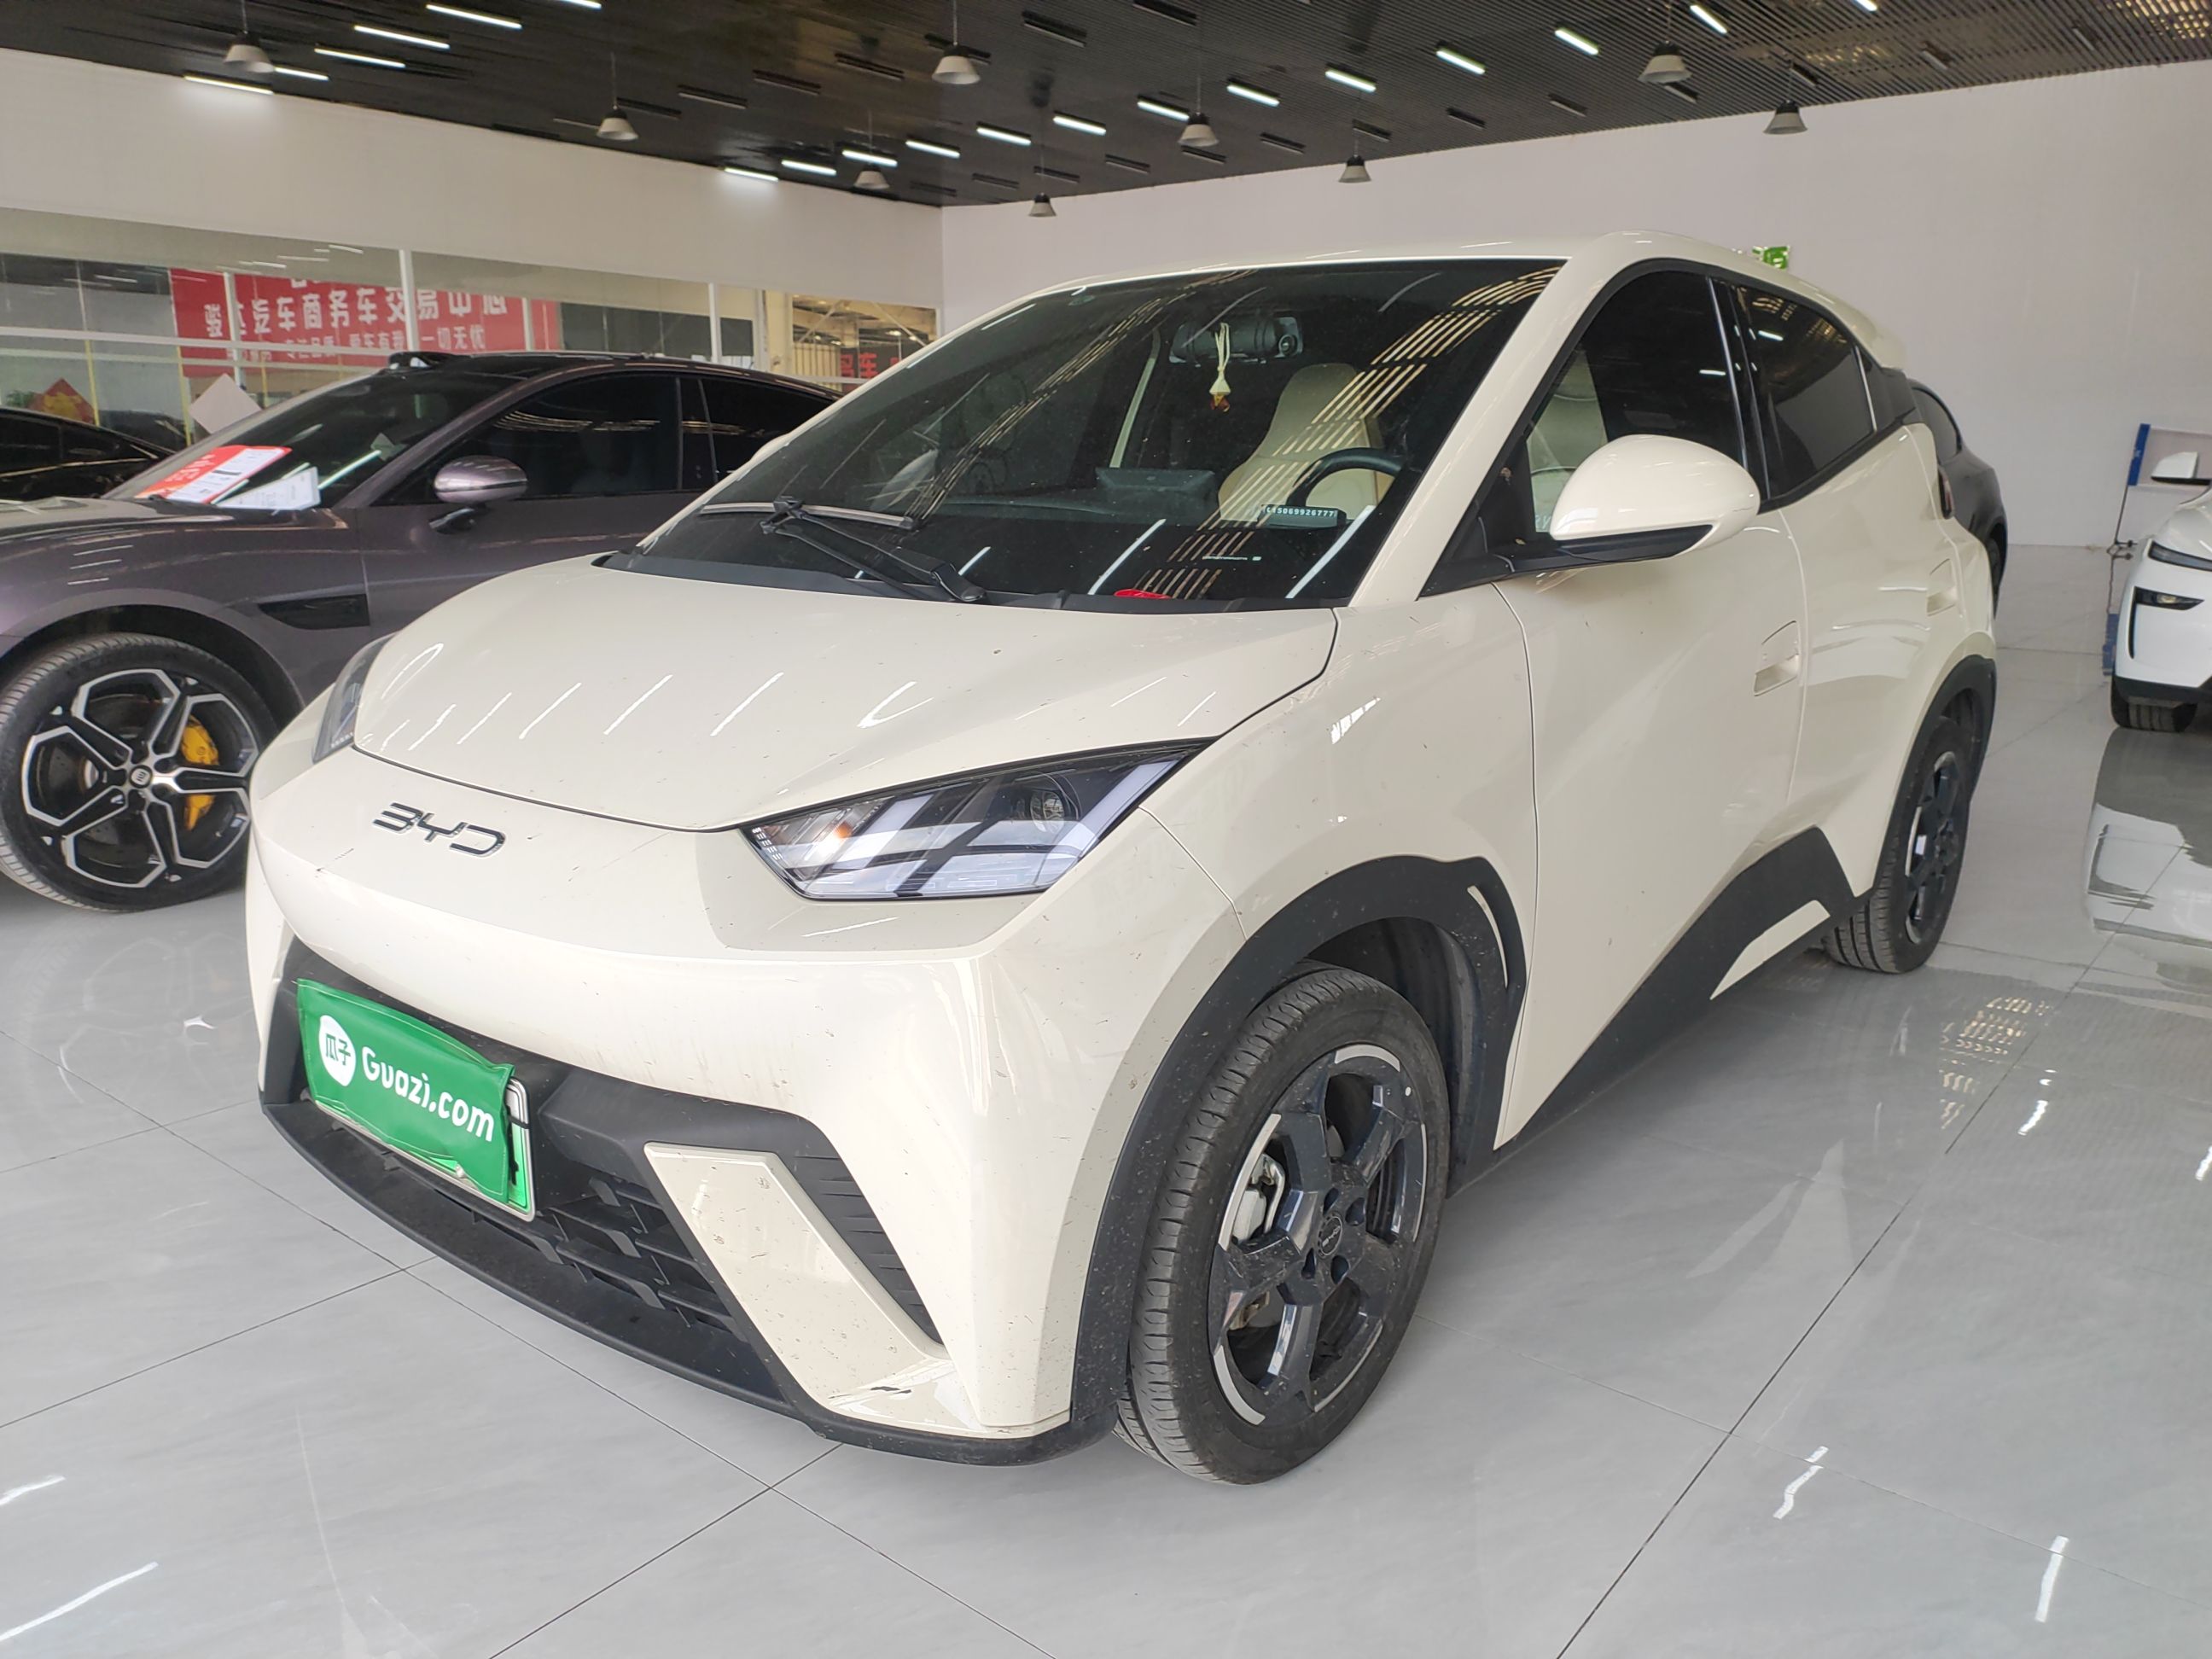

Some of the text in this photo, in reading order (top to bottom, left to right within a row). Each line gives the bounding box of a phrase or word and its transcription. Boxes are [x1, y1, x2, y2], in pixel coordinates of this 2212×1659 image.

[203, 287, 508, 338] 骏汽车商务车交易中心
[372, 802, 506, 858] BYD
[324, 1033, 352, 1067] 瓜子
[362, 1046, 494, 1142] Guazi.com
